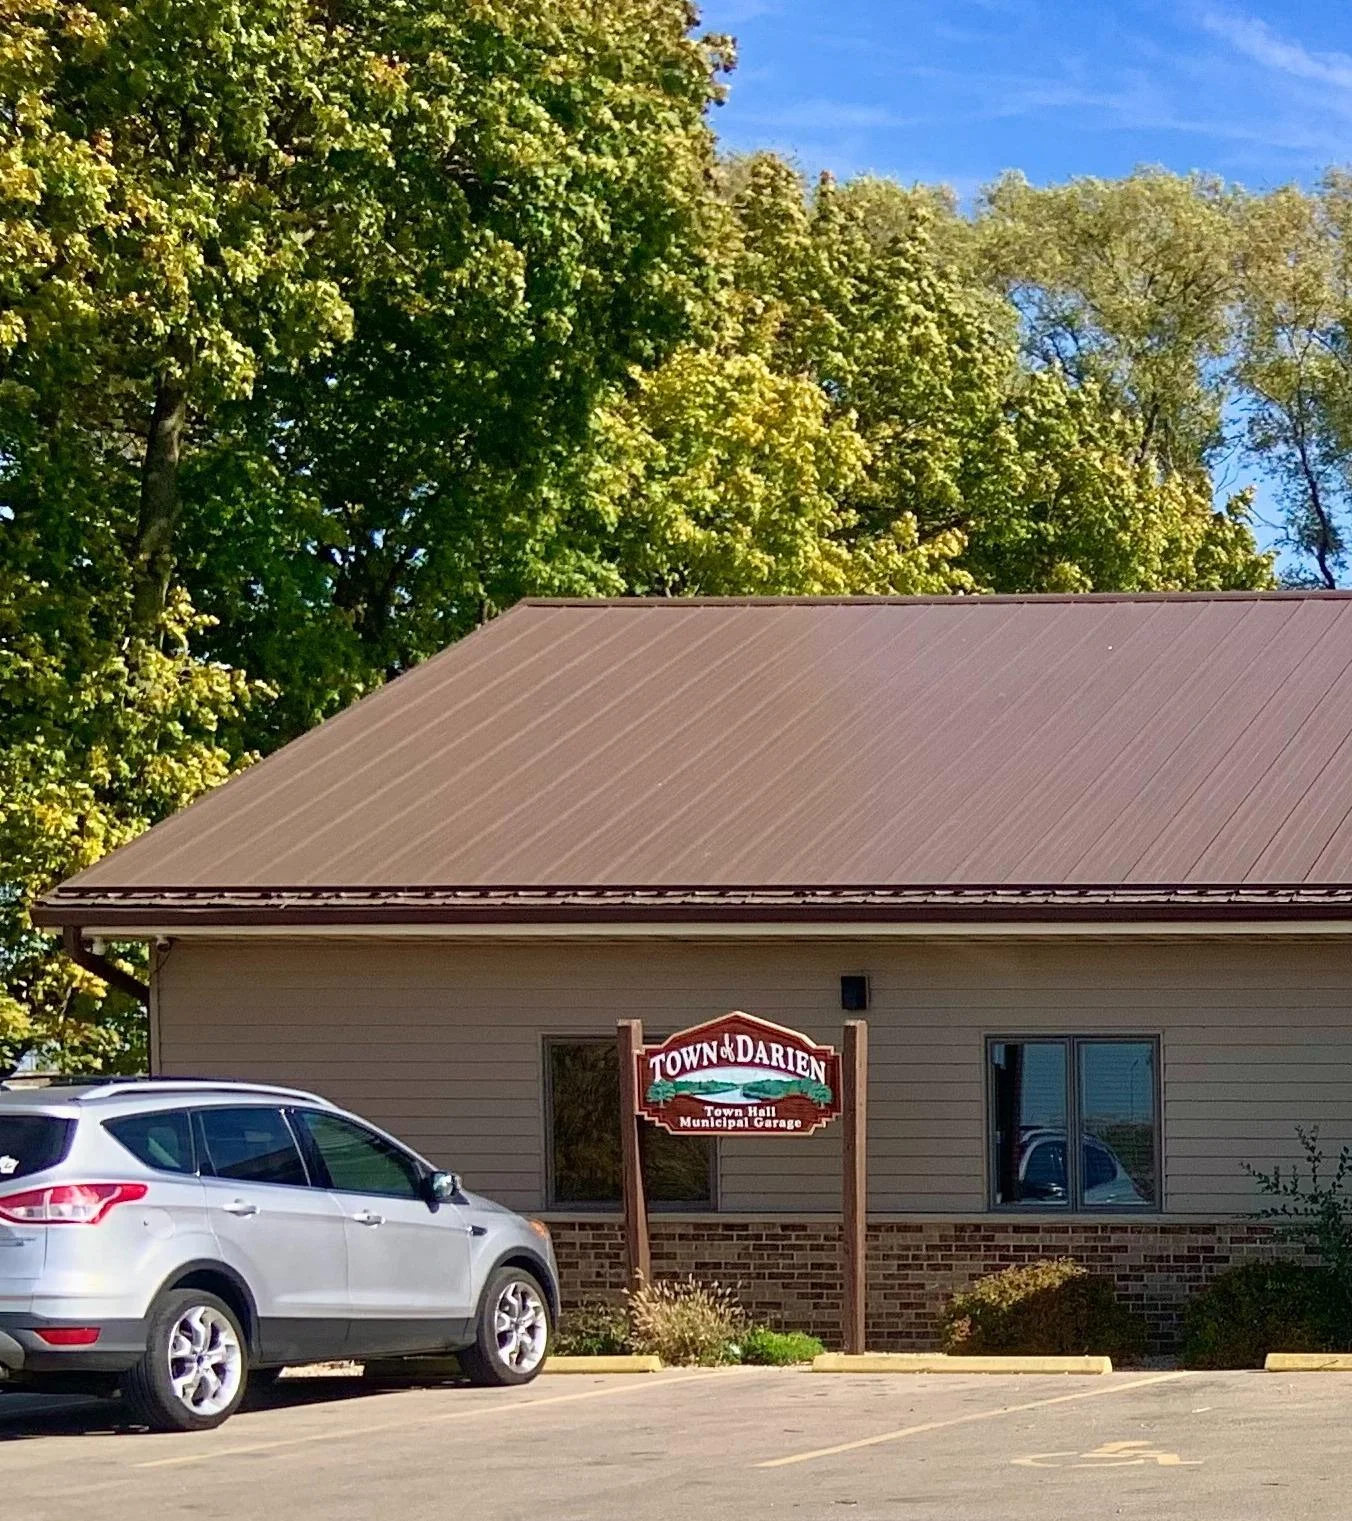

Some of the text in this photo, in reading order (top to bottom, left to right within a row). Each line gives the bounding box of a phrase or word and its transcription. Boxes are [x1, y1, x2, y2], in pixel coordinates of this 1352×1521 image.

[649, 1033, 827, 1085] TOWN of DARIEN
[704, 1106, 776, 1117] Town Hall
[680, 1117, 802, 1130] Municipal Garage
